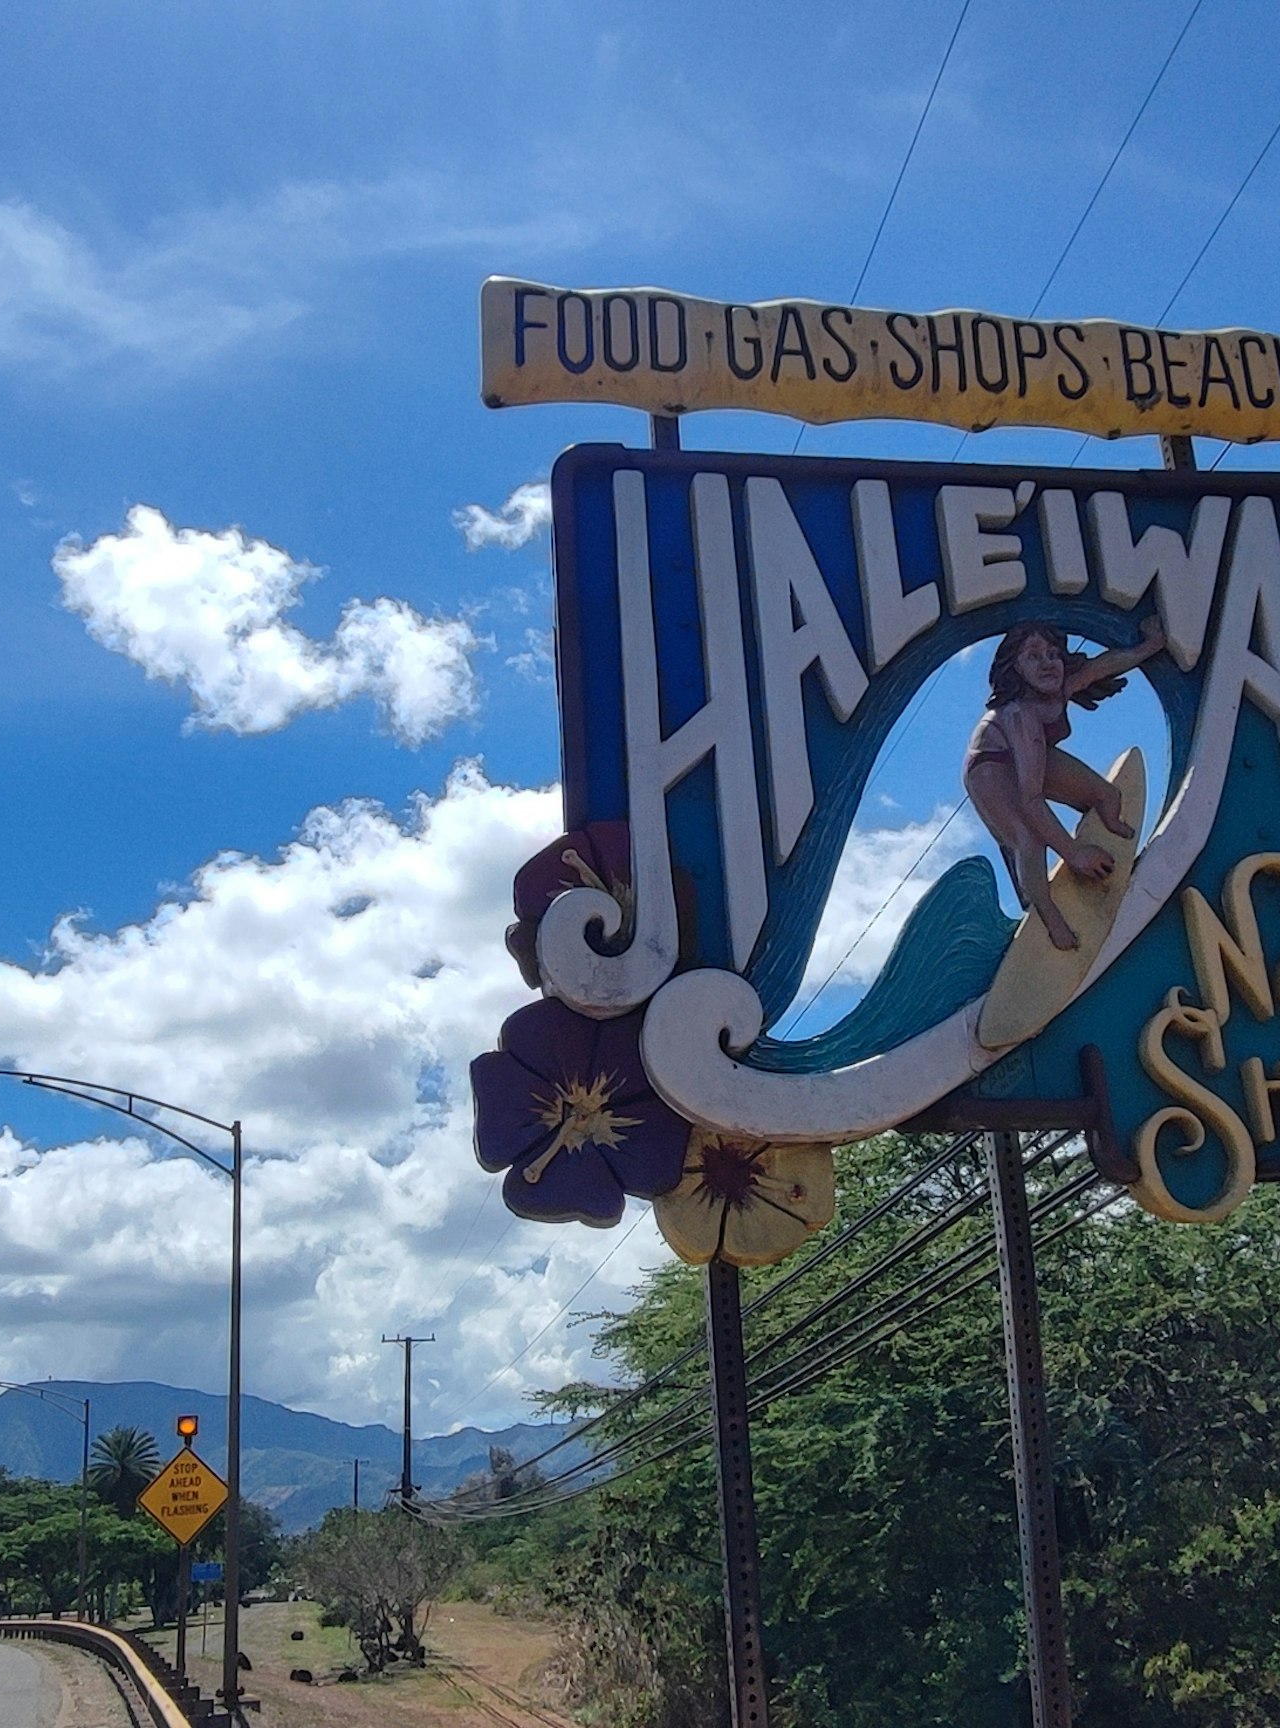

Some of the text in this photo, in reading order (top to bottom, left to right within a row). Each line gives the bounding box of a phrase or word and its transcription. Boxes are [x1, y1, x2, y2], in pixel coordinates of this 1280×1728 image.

[514, 288, 686, 374] FOOD
[723, 303, 858, 386] GAS
[886, 312, 1091, 399] SHOPS
[174, 1463, 198, 1475] STOP
[170, 1477, 202, 1488] AHEAD
[172, 1491, 198, 1502] WHEN
[162, 1504, 209, 1516] FLASHING
